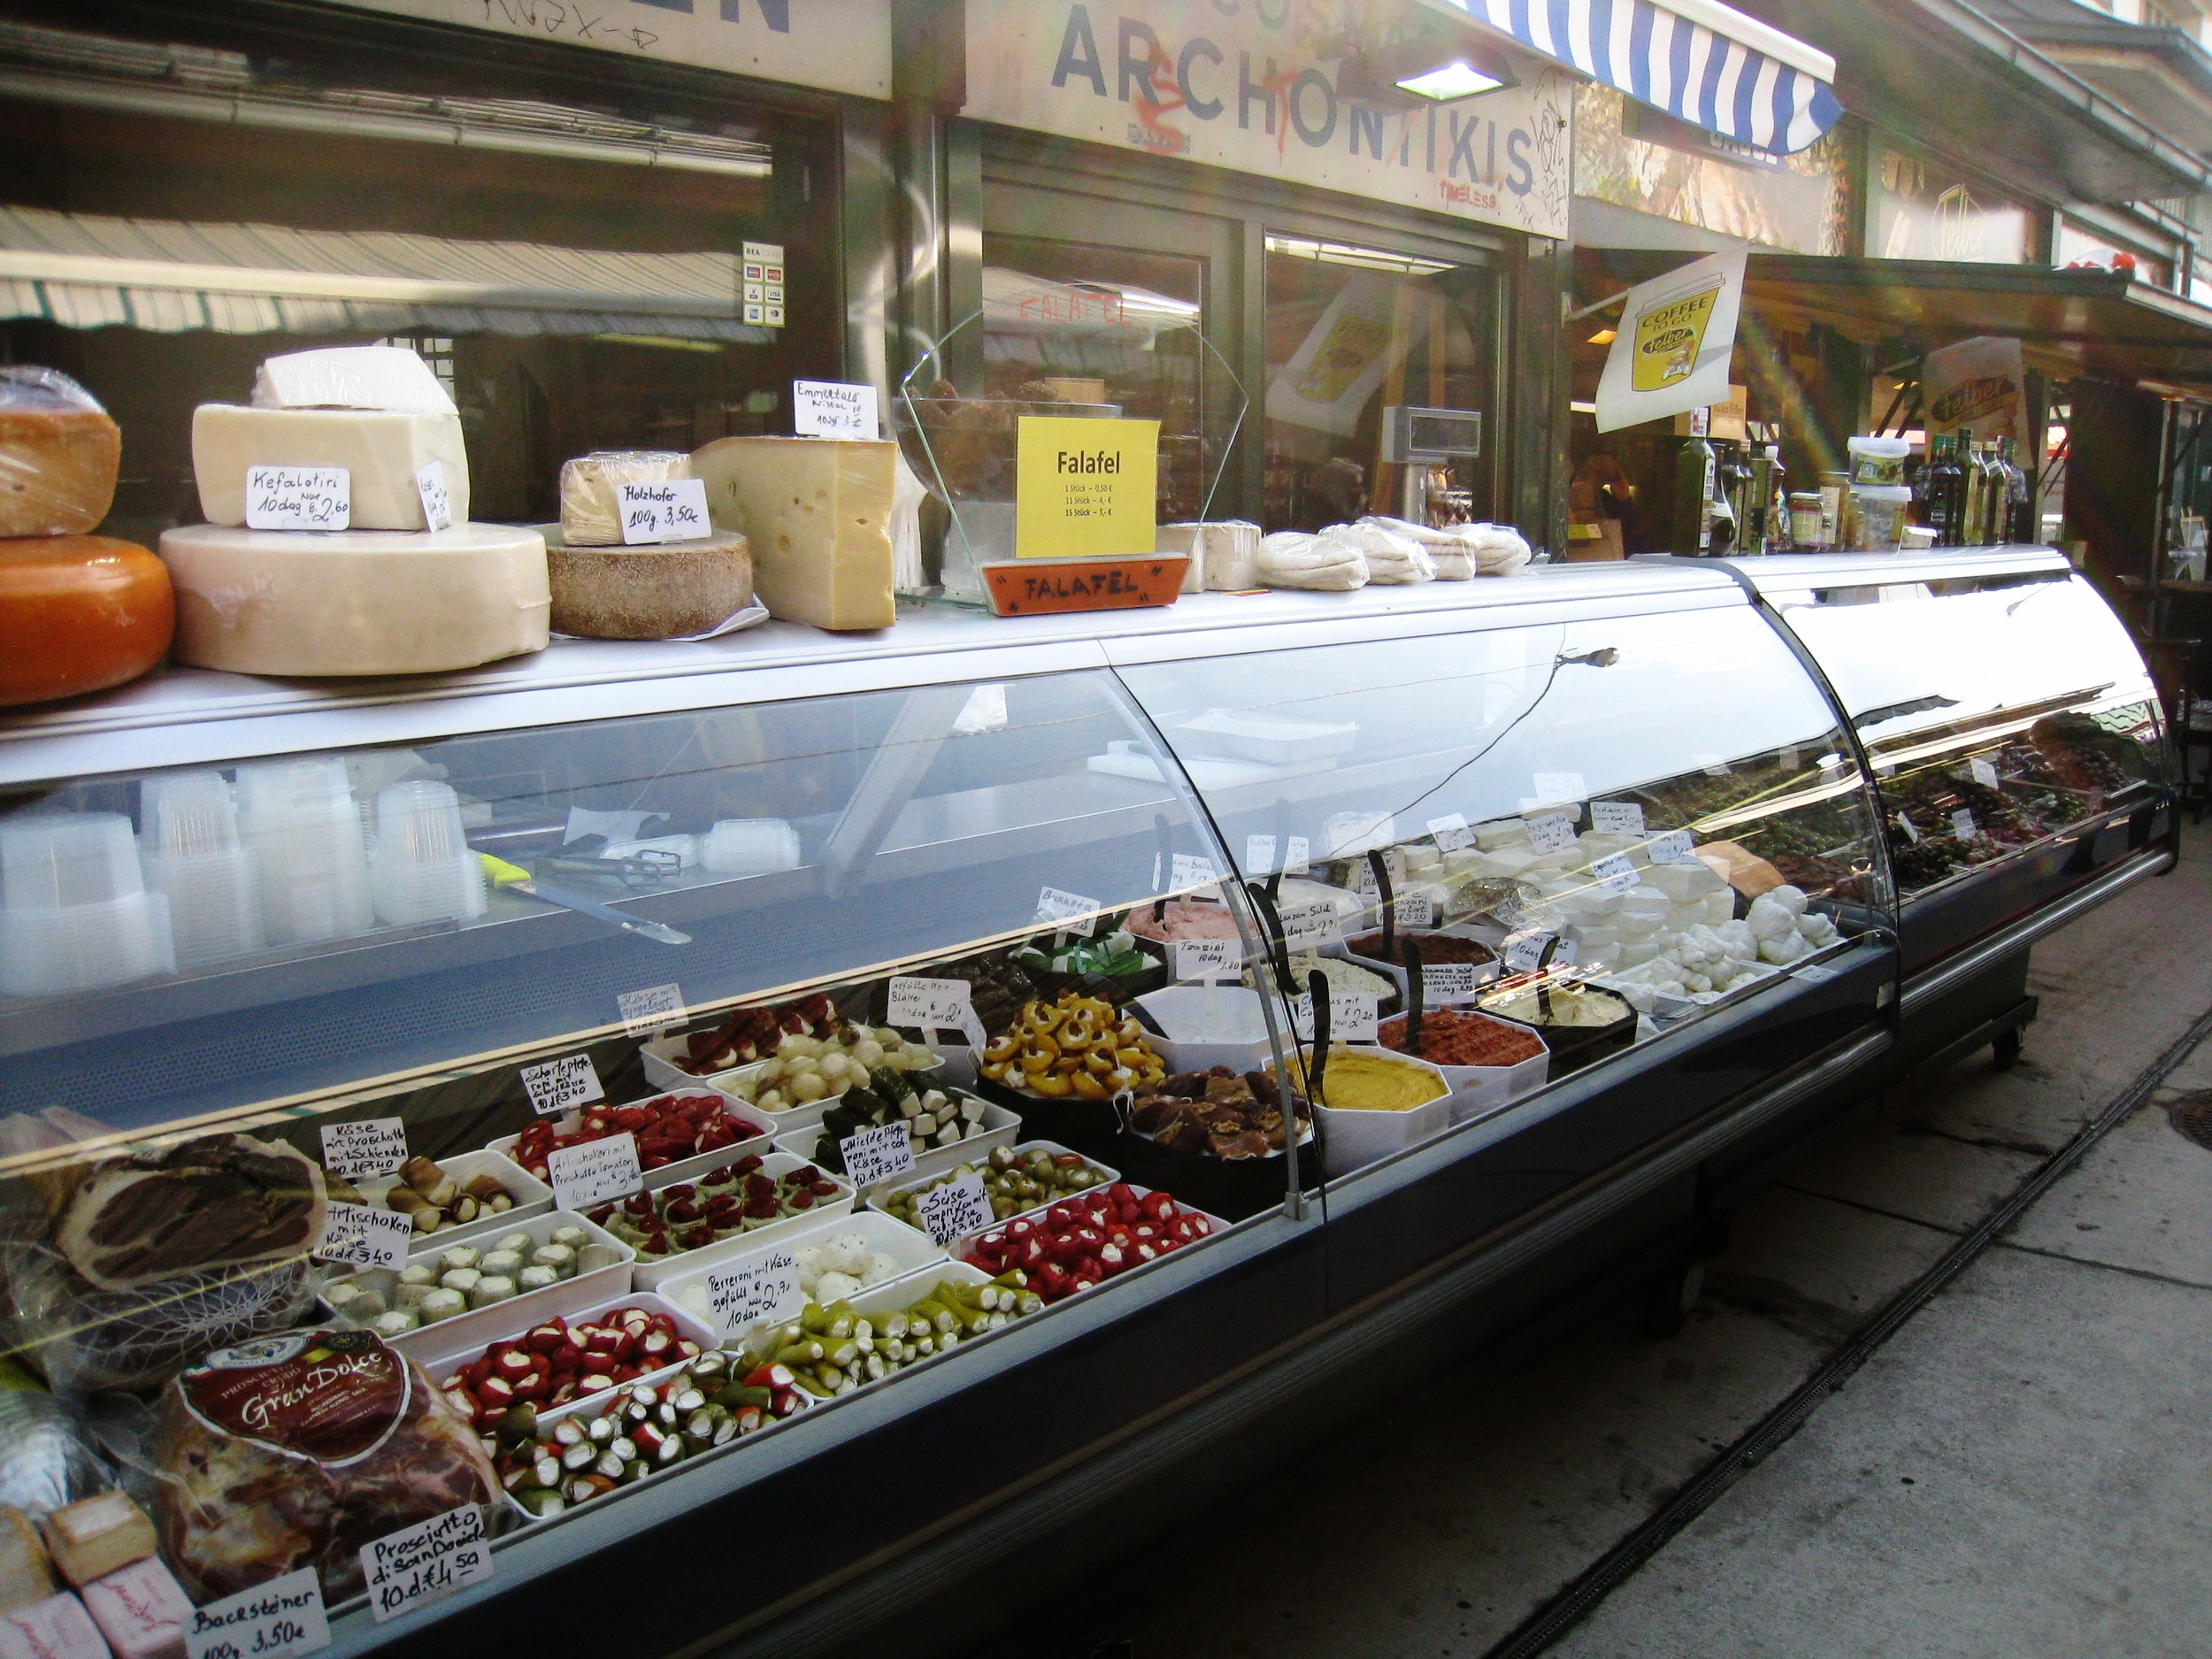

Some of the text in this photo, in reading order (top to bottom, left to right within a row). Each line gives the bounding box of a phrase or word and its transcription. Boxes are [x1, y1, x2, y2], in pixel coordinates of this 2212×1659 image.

[1439, 180, 1498, 210] TIMELESS
[1019, 293, 1133, 327] FALAFEL
[1642, 296, 1709, 327] COFFEE
[1653, 314, 1692, 332] TO GO
[1057, 450, 1120, 474] Falafel
[253, 472, 340, 495] Kefalotiri
[626, 486, 677, 502] Holzhofer
[1025, 570, 1139, 600] FALAFEL
[1345, 995, 1359, 1005] mit
[336, 1124, 378, 1136] Käse
[870, 1142, 888, 1156] mit
[853, 1156, 882, 1170] Käse
[338, 1225, 368, 1239] mit
[713, 1286, 747, 1313] gefüllt
[242, 1384, 315, 1431] Gran
[375, 1511, 477, 1563] Prosciutto
[373, 1561, 390, 1585] di
